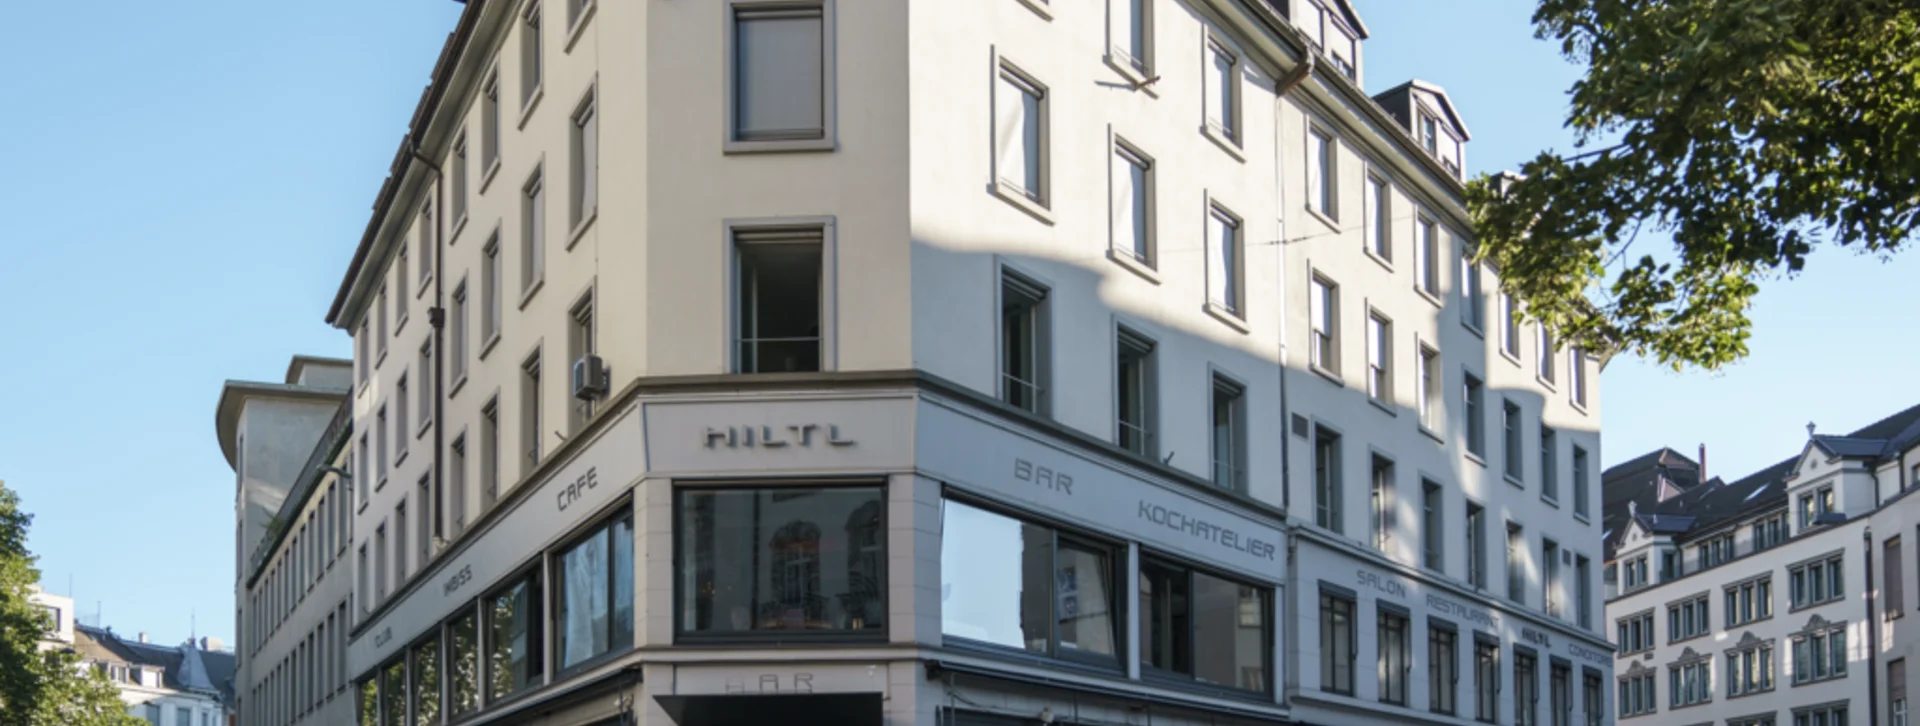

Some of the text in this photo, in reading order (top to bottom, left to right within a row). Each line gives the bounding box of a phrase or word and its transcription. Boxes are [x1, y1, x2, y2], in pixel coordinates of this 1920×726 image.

[704, 424, 857, 448] HILTL
[557, 466, 599, 512] CAFE
[1014, 457, 1276, 562] BAR KOCHATELIER
[1356, 569, 1406, 599] SALON
